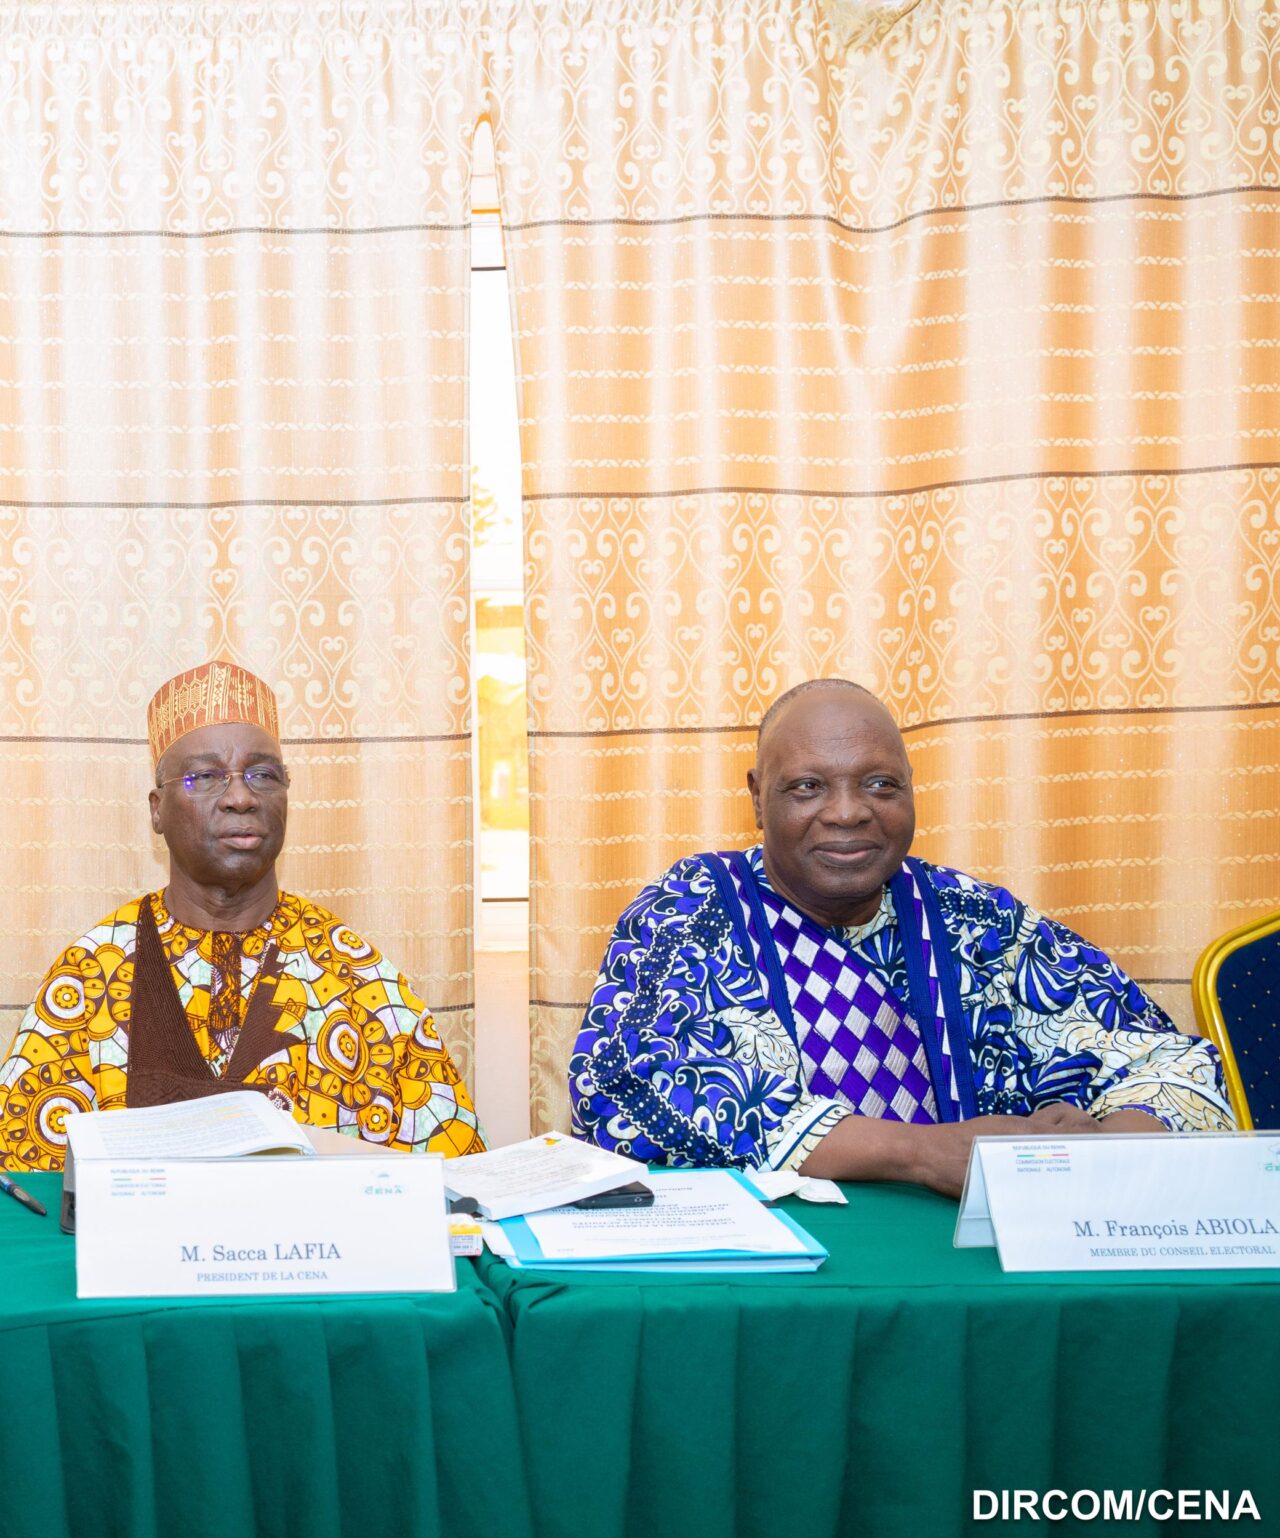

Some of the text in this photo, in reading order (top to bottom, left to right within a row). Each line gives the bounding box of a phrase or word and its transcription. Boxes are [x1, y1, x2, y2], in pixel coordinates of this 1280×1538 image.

[1073, 1218, 1279, 1239] M. François ABIOLA
[181, 1243, 341, 1262] M. Sacca LAFIA
[1090, 1246, 1276, 1257] MEMBRE DU CONSEIL ELECTORAL
[197, 1270, 328, 1282] PRESIDENT DE LA CENA
